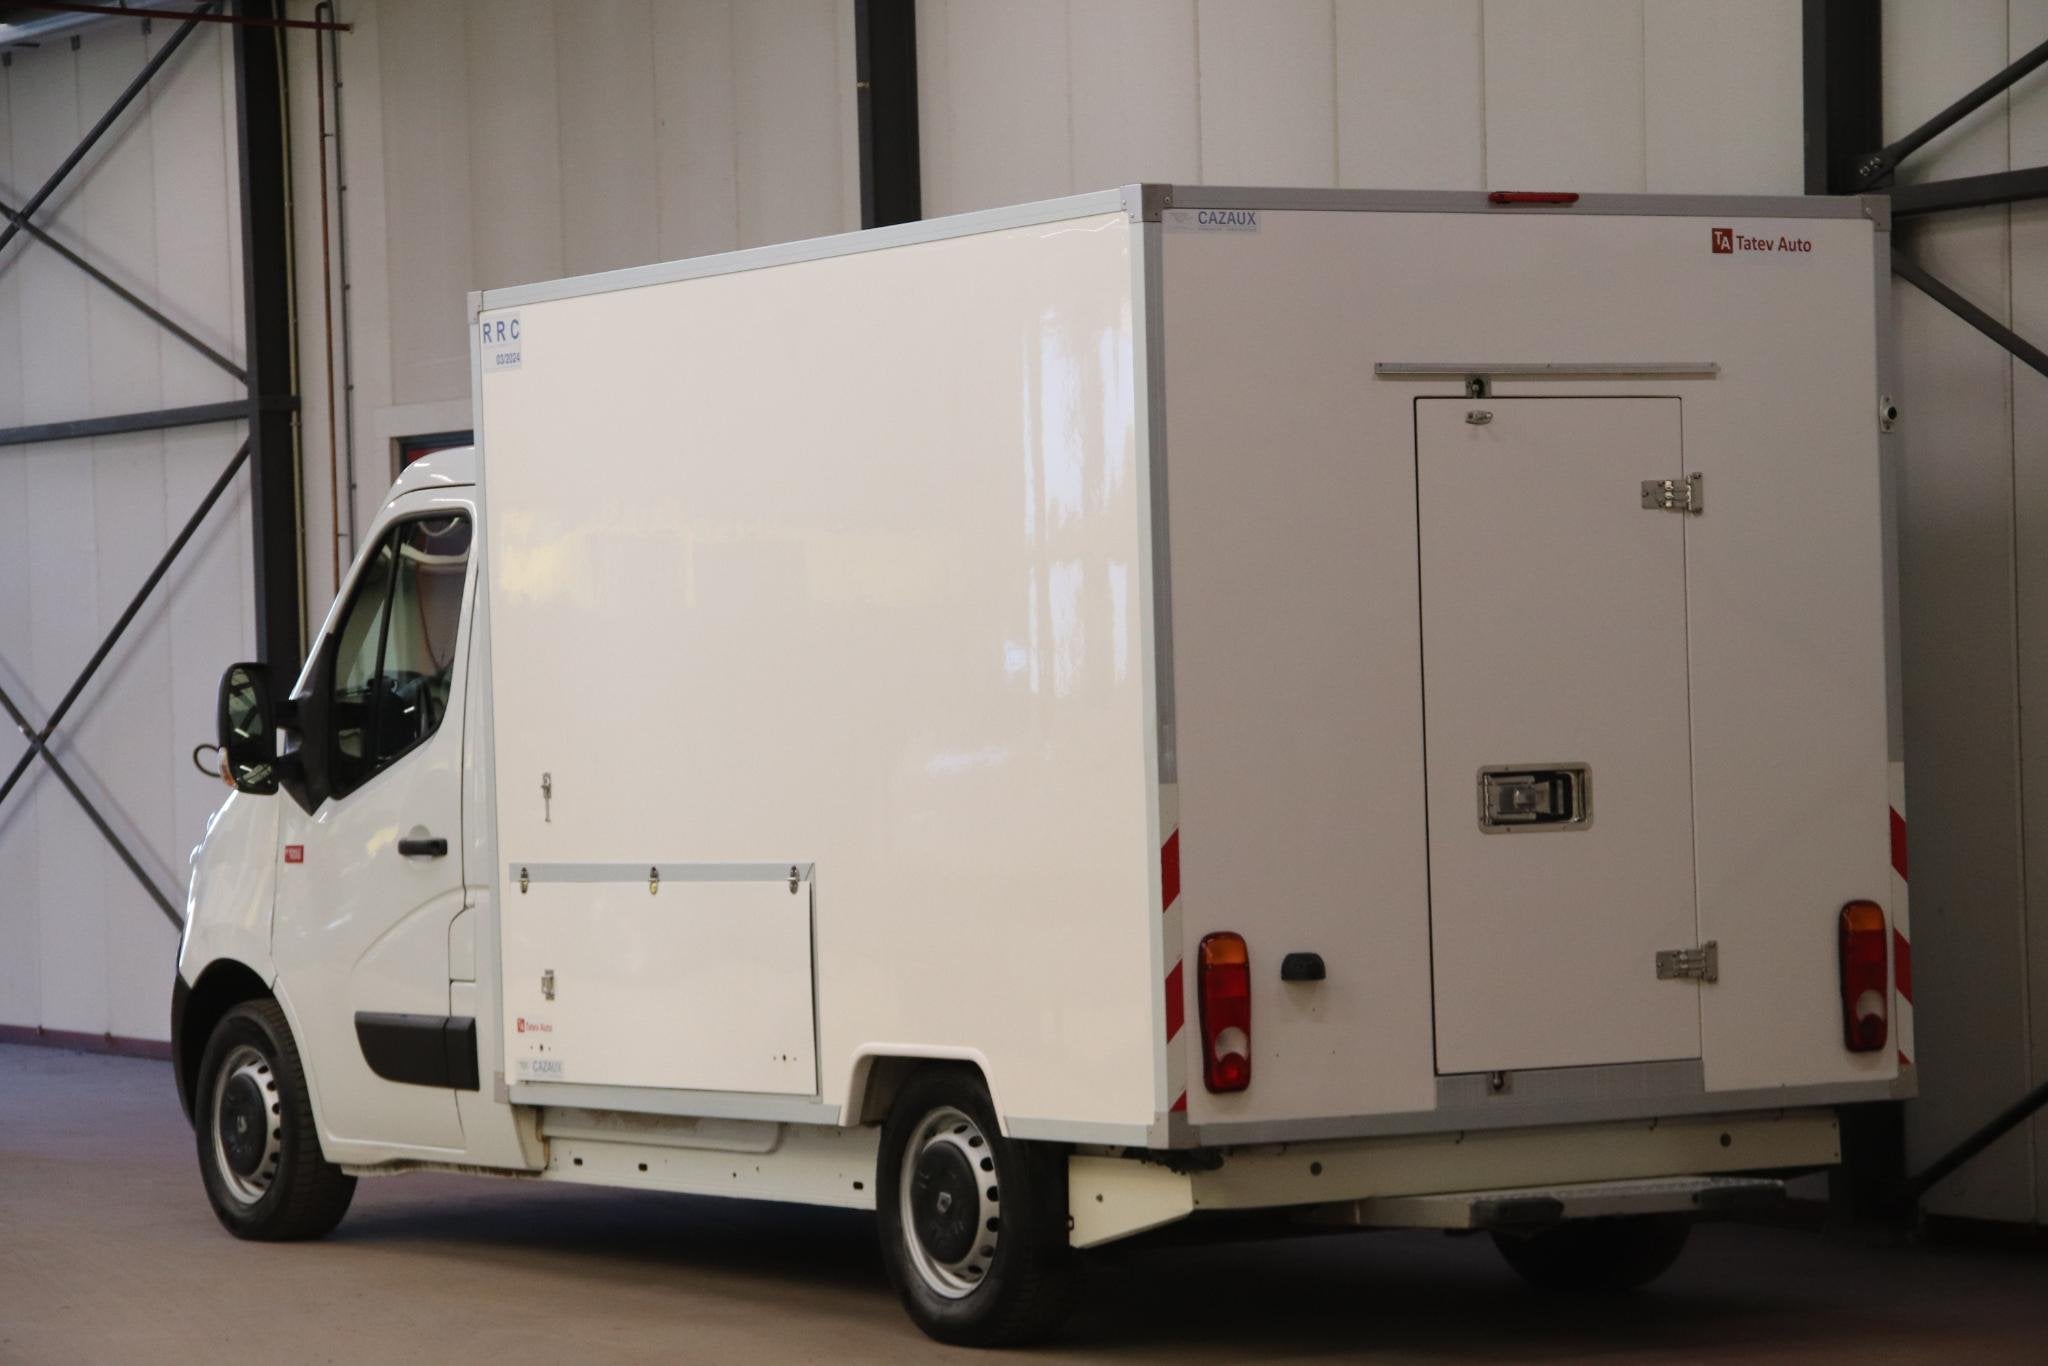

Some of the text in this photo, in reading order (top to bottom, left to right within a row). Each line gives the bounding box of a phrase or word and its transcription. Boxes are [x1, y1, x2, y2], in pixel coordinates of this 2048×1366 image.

[1198, 211, 1256, 225] CAZAUX
[1714, 231, 1811, 252] TA Tatev Auto
